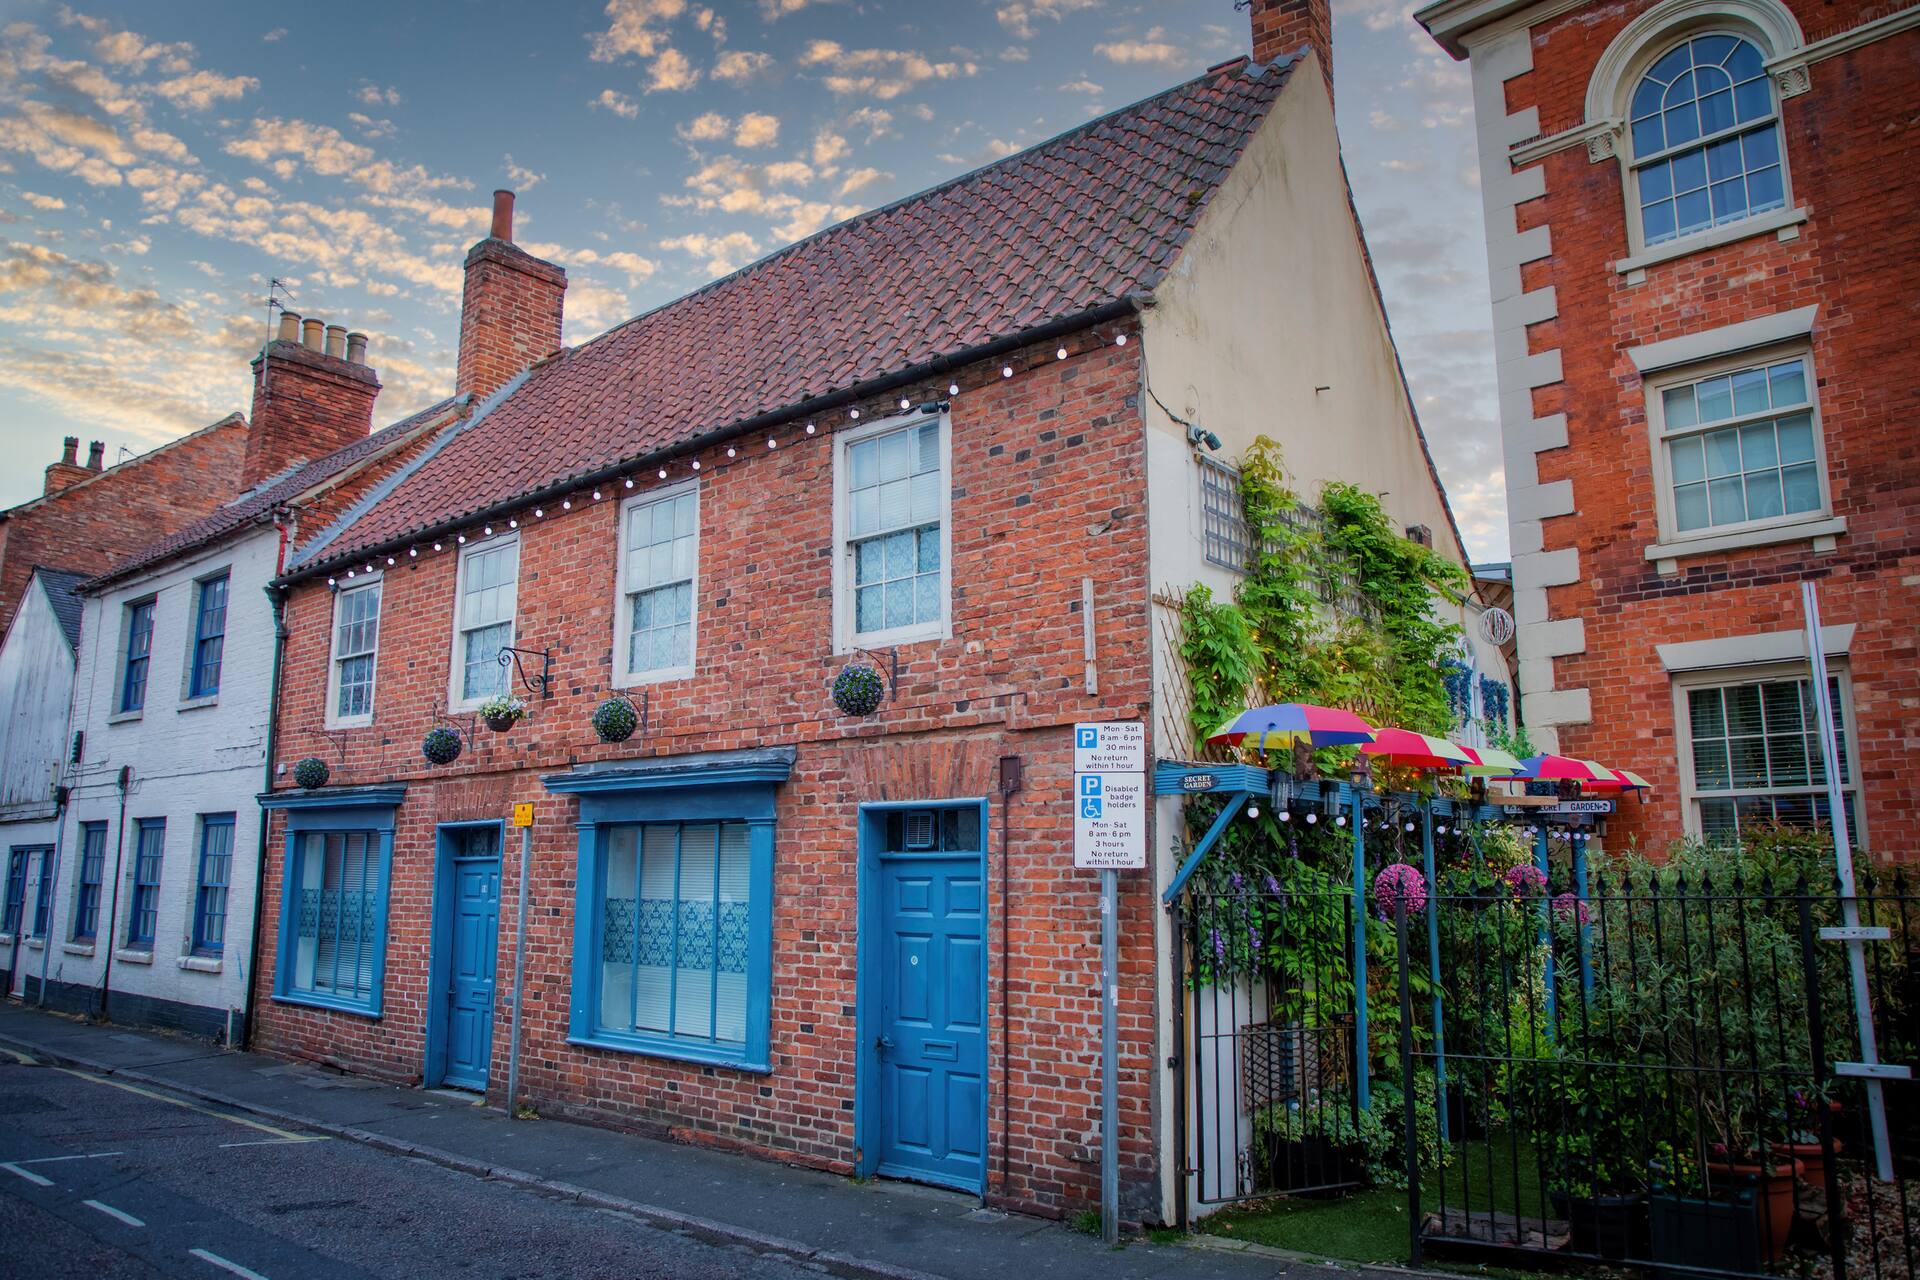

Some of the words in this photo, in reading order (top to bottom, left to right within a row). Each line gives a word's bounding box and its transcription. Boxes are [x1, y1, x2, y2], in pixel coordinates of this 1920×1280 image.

[1110, 793, 1134, 801] badge
[1107, 801, 1137, 809] holders
[1113, 821, 1127, 829] Sat
[1102, 840, 1125, 848] hours
[1091, 850, 1102, 858] No
[1086, 858, 1110, 866] within
[1117, 858, 1134, 866] hour
